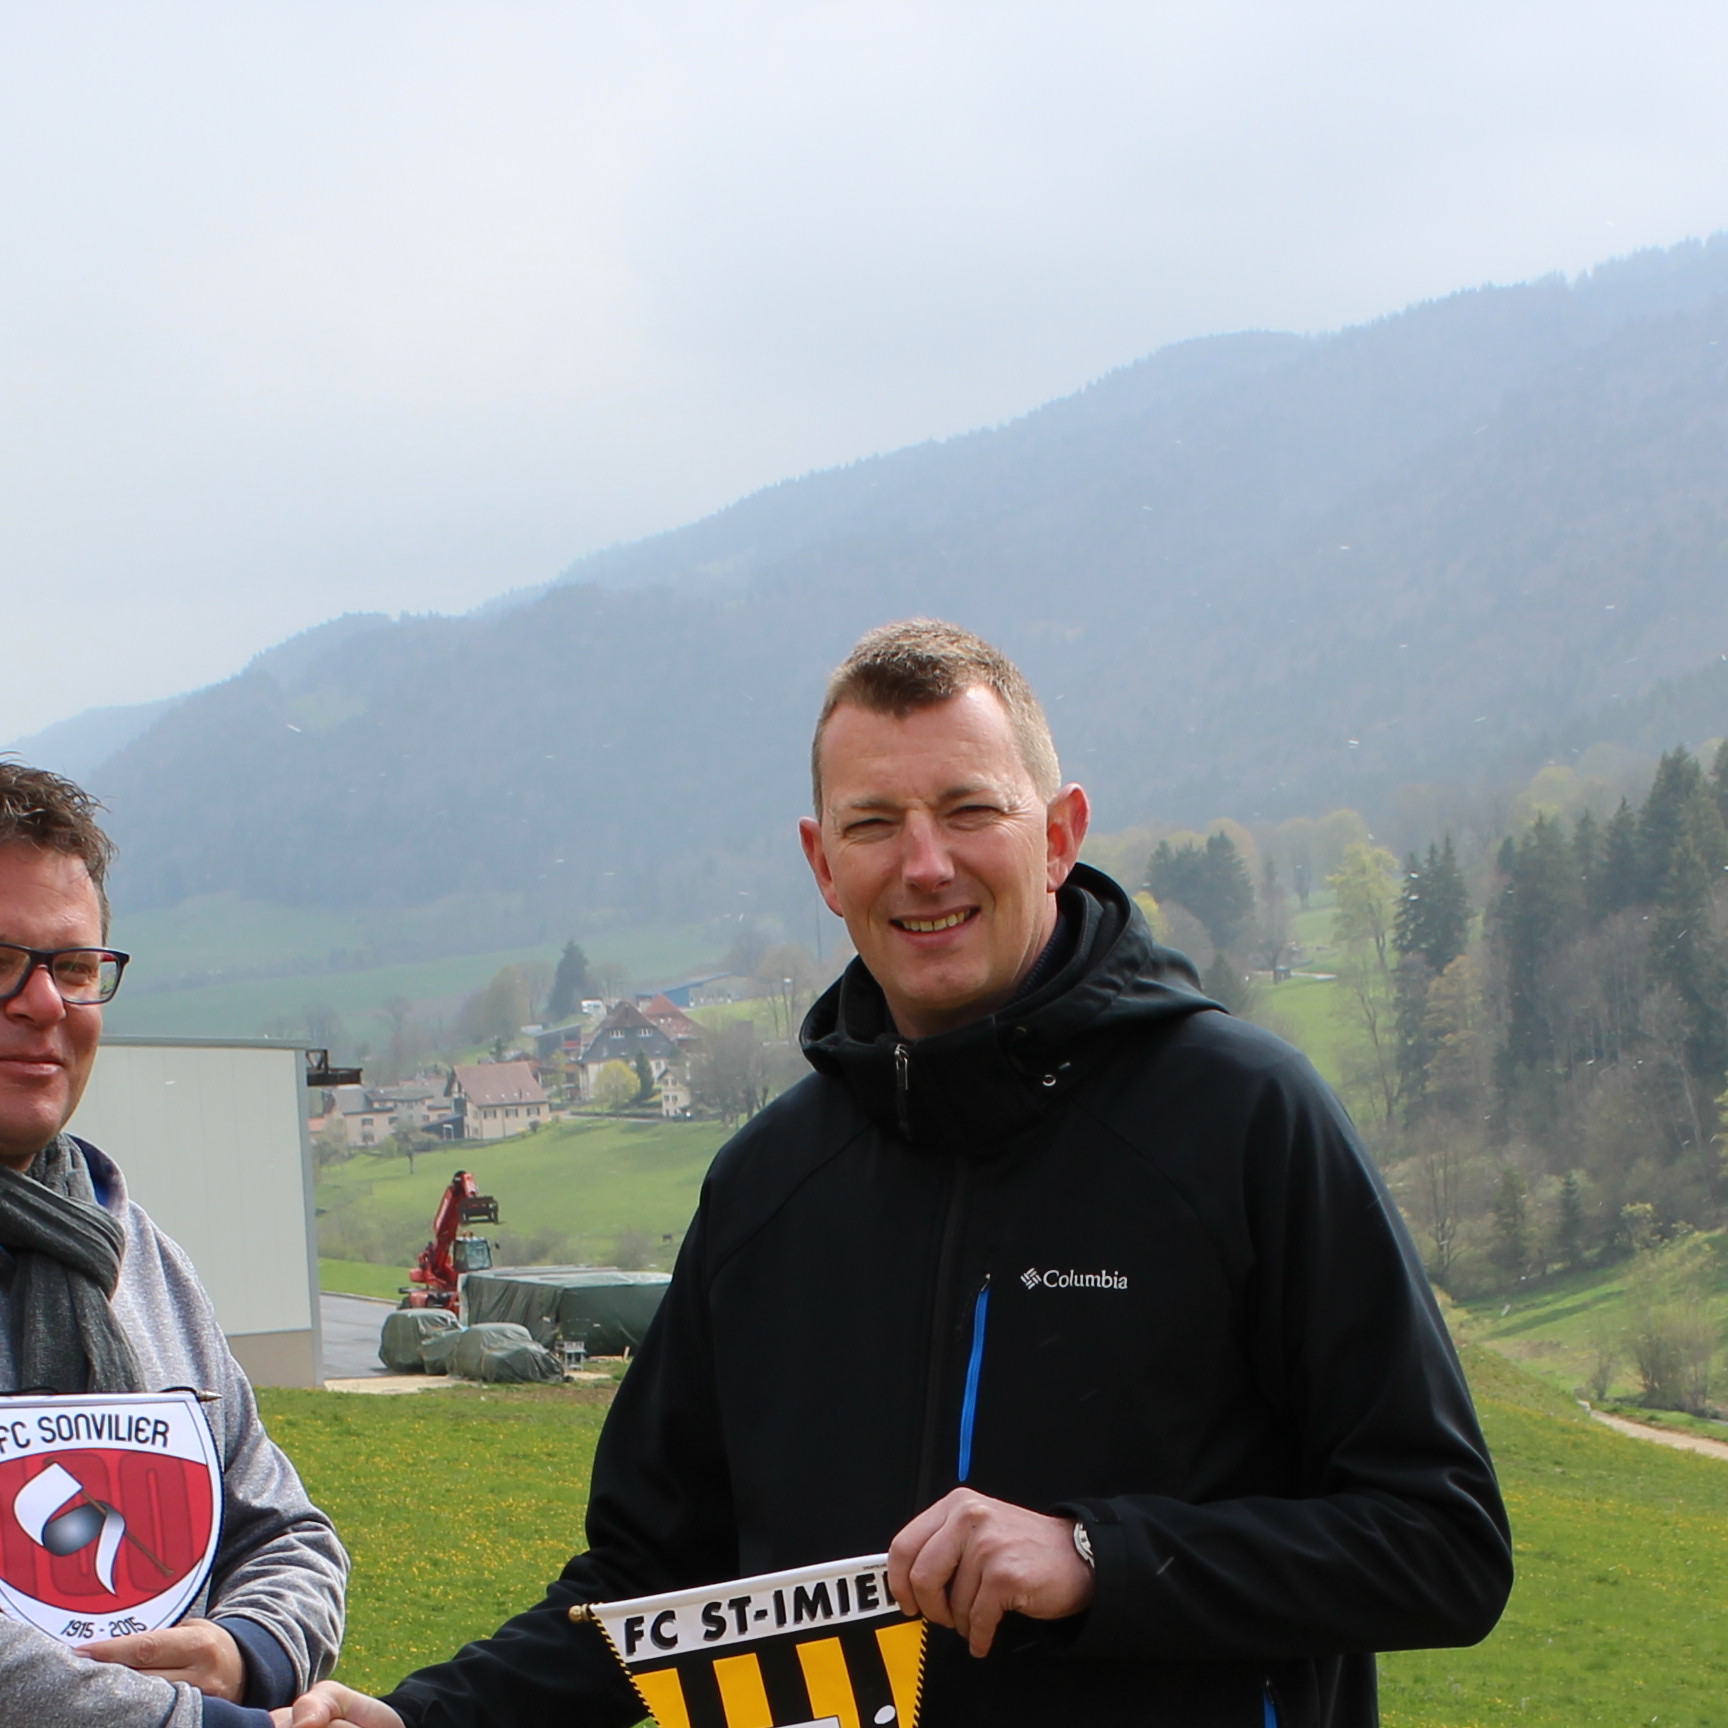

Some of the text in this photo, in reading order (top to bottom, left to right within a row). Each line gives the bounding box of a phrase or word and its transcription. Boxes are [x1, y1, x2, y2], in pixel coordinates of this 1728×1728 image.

[1042, 1269, 1128, 1289] Columbia
[37, 1413, 170, 1448] SONVILIER
[60, 1619, 94, 1639] 1915
[108, 1615, 147, 1638] 2015
[623, 1610, 678, 1657] FC
